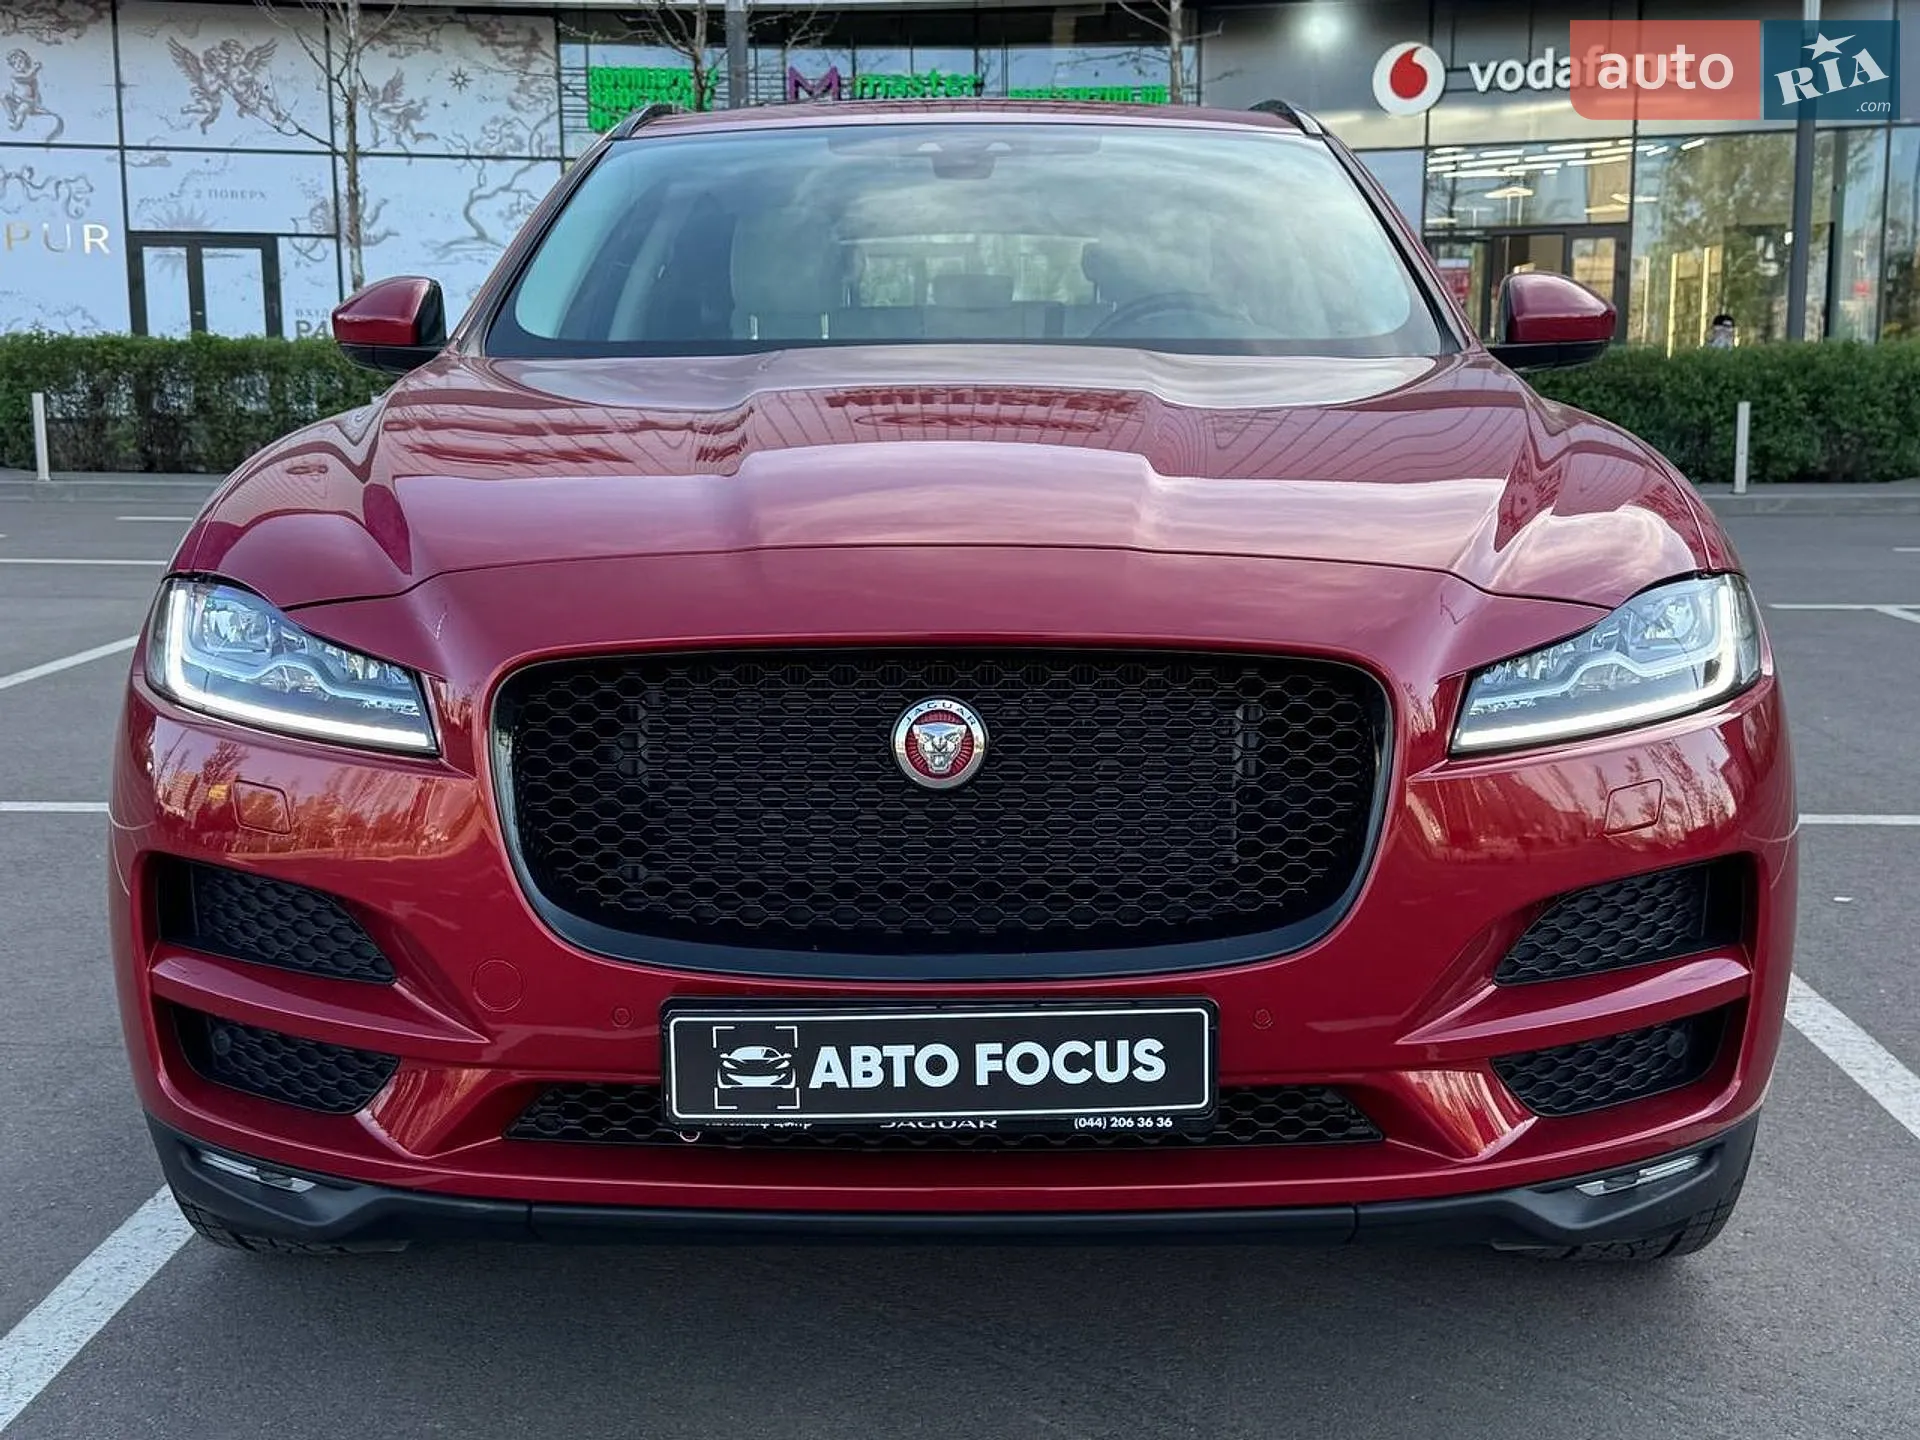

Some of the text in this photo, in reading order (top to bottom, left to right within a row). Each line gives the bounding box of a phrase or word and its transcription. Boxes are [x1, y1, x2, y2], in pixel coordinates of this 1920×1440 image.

[853, 67, 980, 98] master
[905, 702, 977, 727] JAGUAR
[974, 1038, 1167, 1086] FOCUS
[1074, 1116, 1173, 1129] (044) 206 36 36
